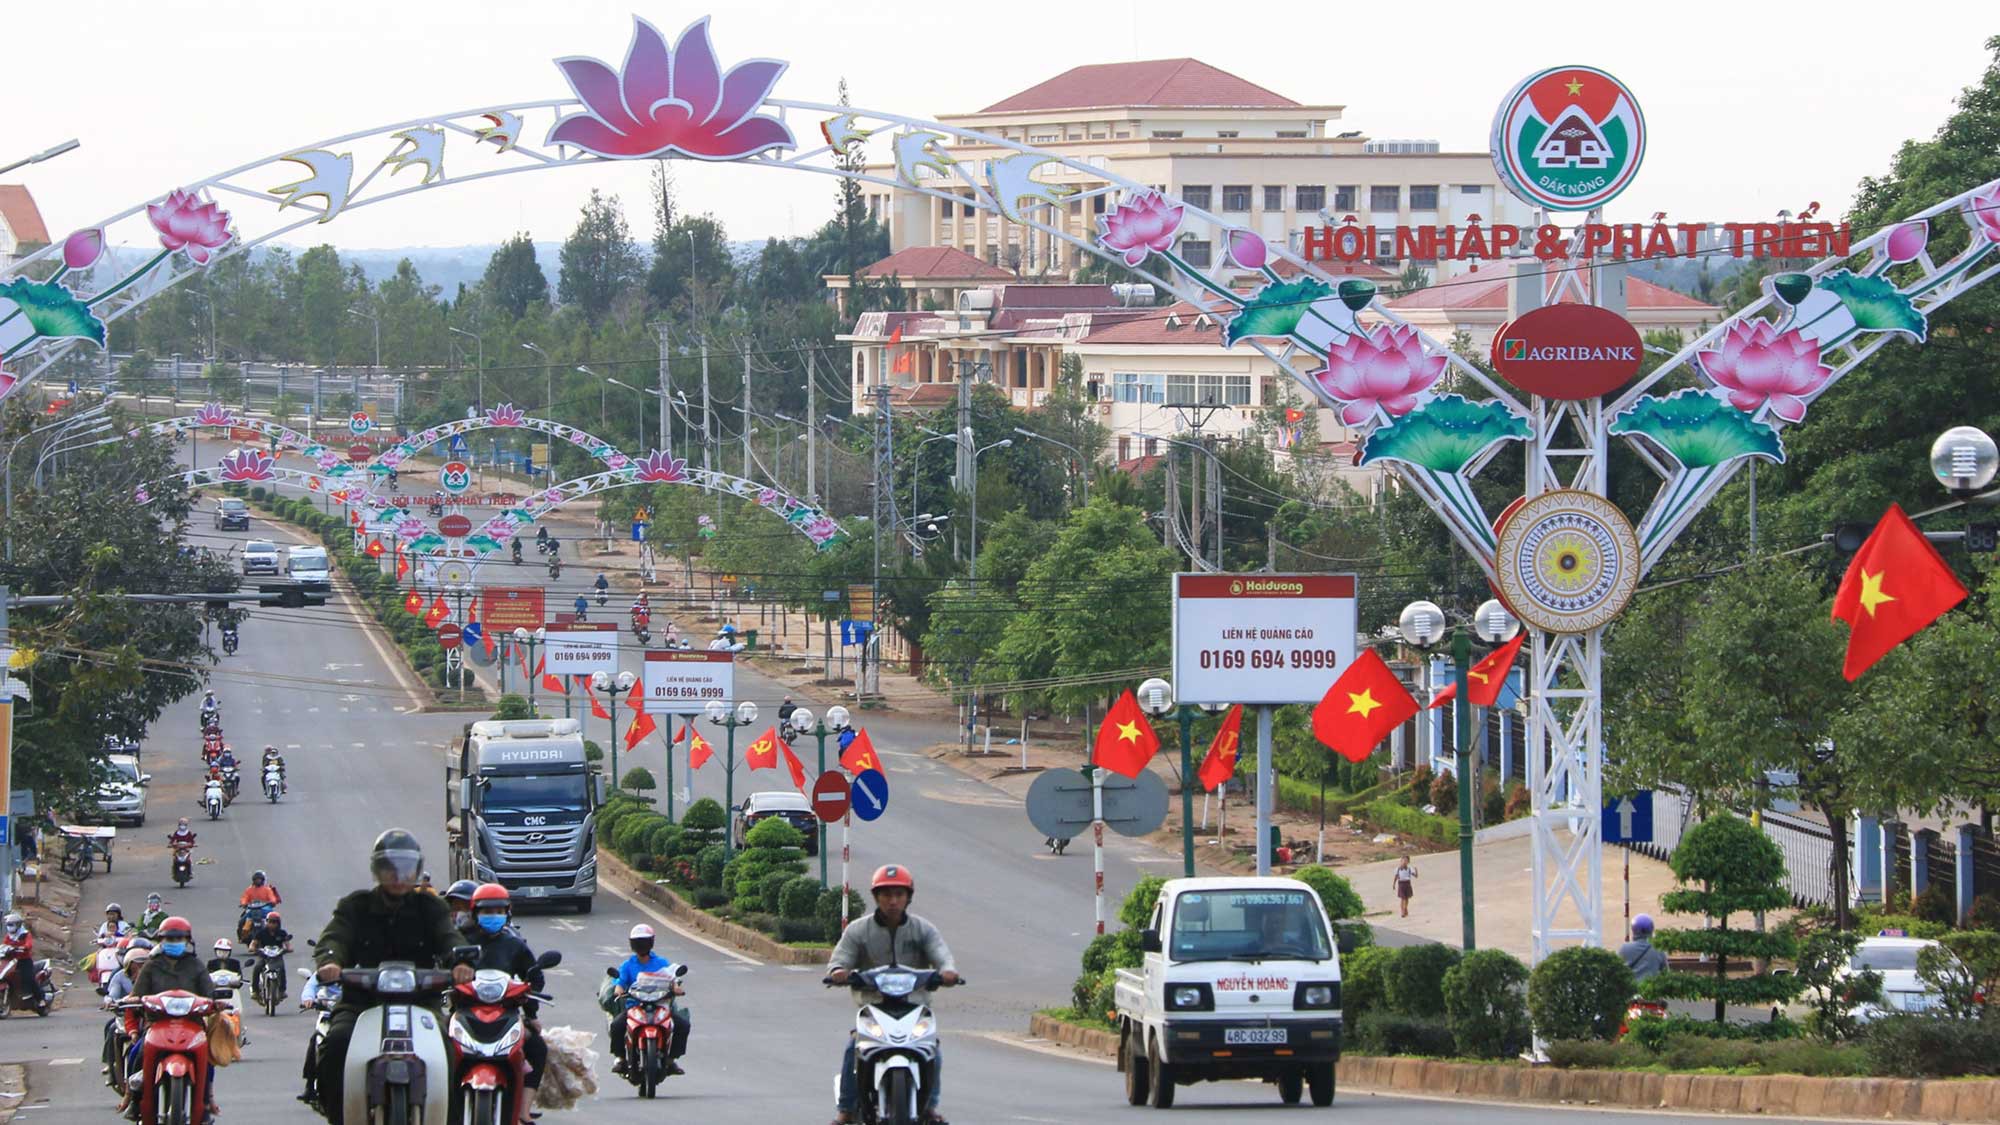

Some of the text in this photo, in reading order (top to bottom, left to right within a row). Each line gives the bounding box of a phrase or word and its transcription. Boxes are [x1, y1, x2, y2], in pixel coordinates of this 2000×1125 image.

[1568, 176, 1606, 194] NÔNG
[1304, 201, 1850, 273] HỘI NHẬP & PHÁT TRIỂN
[1528, 346, 1636, 361] AGRIBANK
[1246, 581, 1303, 594] Haiduong
[1222, 626, 1313, 641] LIÊN HỆ QUẢNG CÁO
[554, 652, 611, 660] 0169 694 9999
[1200, 649, 1336, 669] 0169 694 9999
[655, 687, 724, 697] 0169 694 9999
[502, 750, 563, 761] HYUNDAI
[524, 816, 546, 826] CMC
[1257, 975, 1288, 990] HOÀNG
